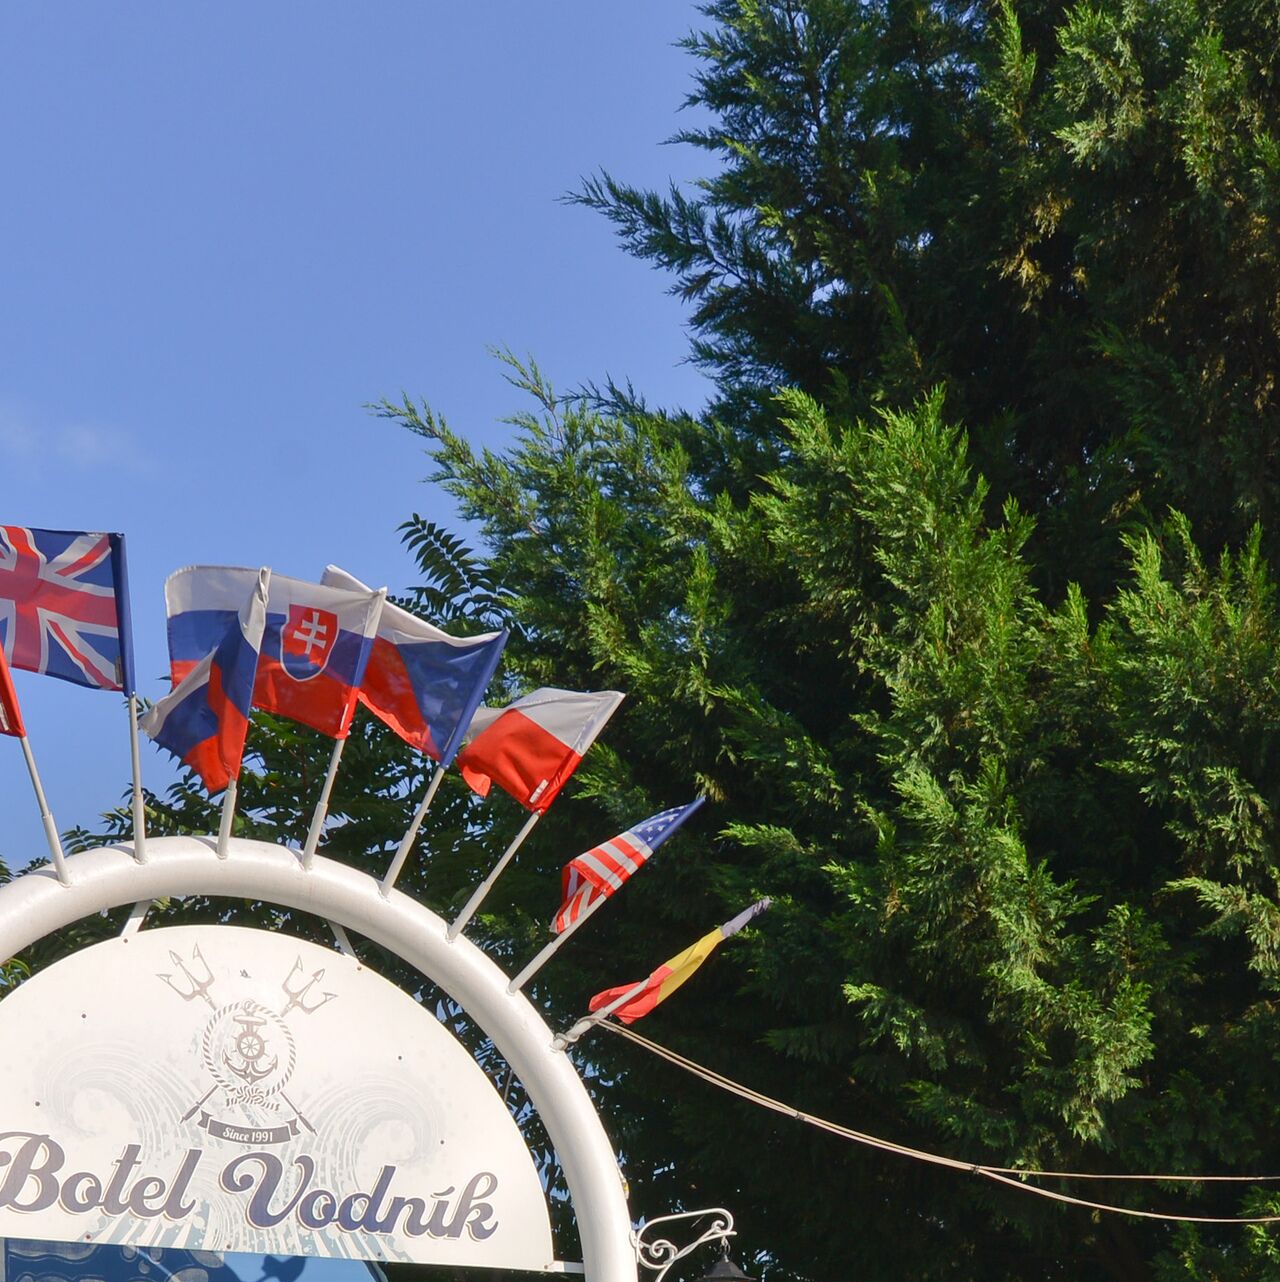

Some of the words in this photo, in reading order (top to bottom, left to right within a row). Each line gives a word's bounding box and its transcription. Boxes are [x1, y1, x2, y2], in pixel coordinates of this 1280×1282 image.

[222, 1126, 250, 1142] Since
[251, 1131, 273, 1143] 1991
[217, 1151, 500, 1241] Vodník
